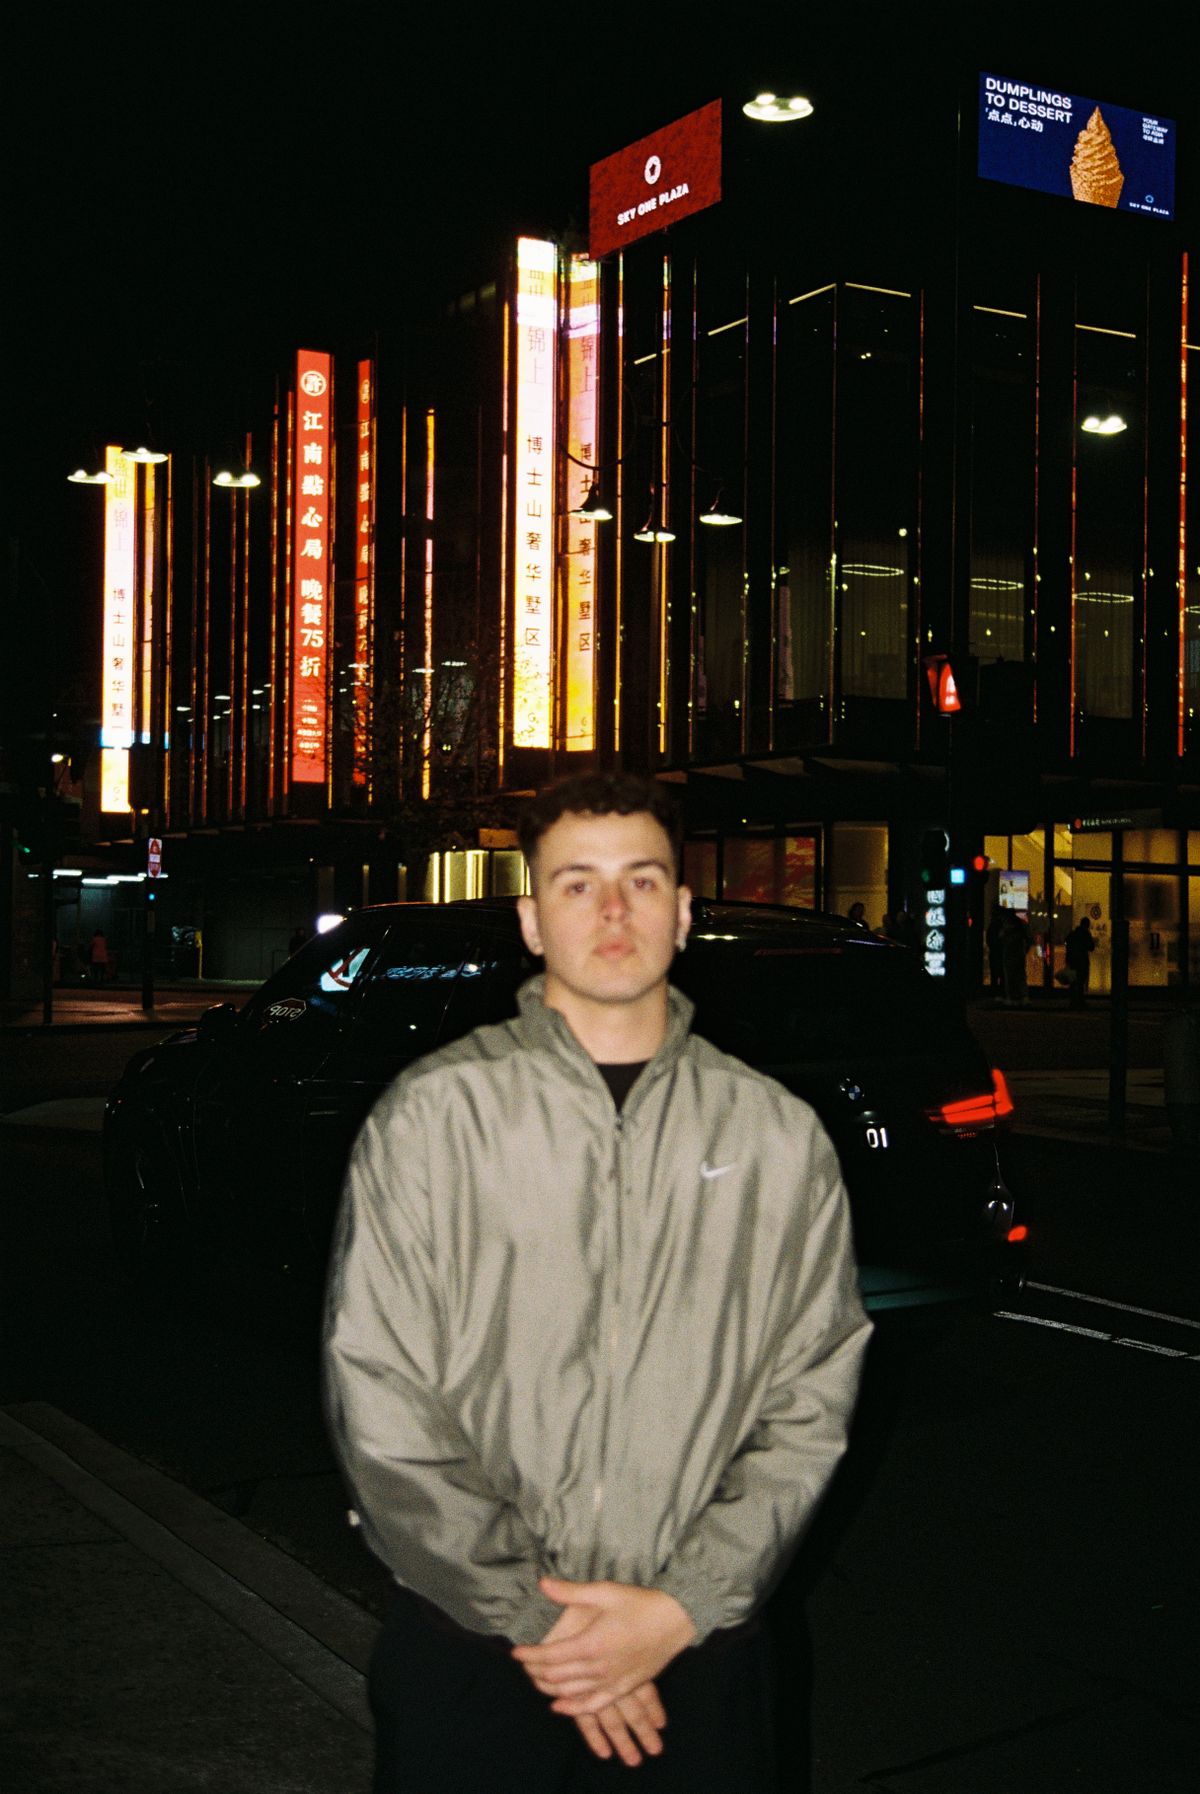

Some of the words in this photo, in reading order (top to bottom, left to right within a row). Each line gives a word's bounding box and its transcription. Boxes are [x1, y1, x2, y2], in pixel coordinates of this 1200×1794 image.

[985, 92, 1006, 107] TO
[1009, 98, 1073, 124] DESSERT
[986, 77, 1072, 109] DUMPLINGS
[617, 207, 636, 226] SKY
[637, 198, 657, 216] ONE
[658, 183, 690, 206] PLAZA
